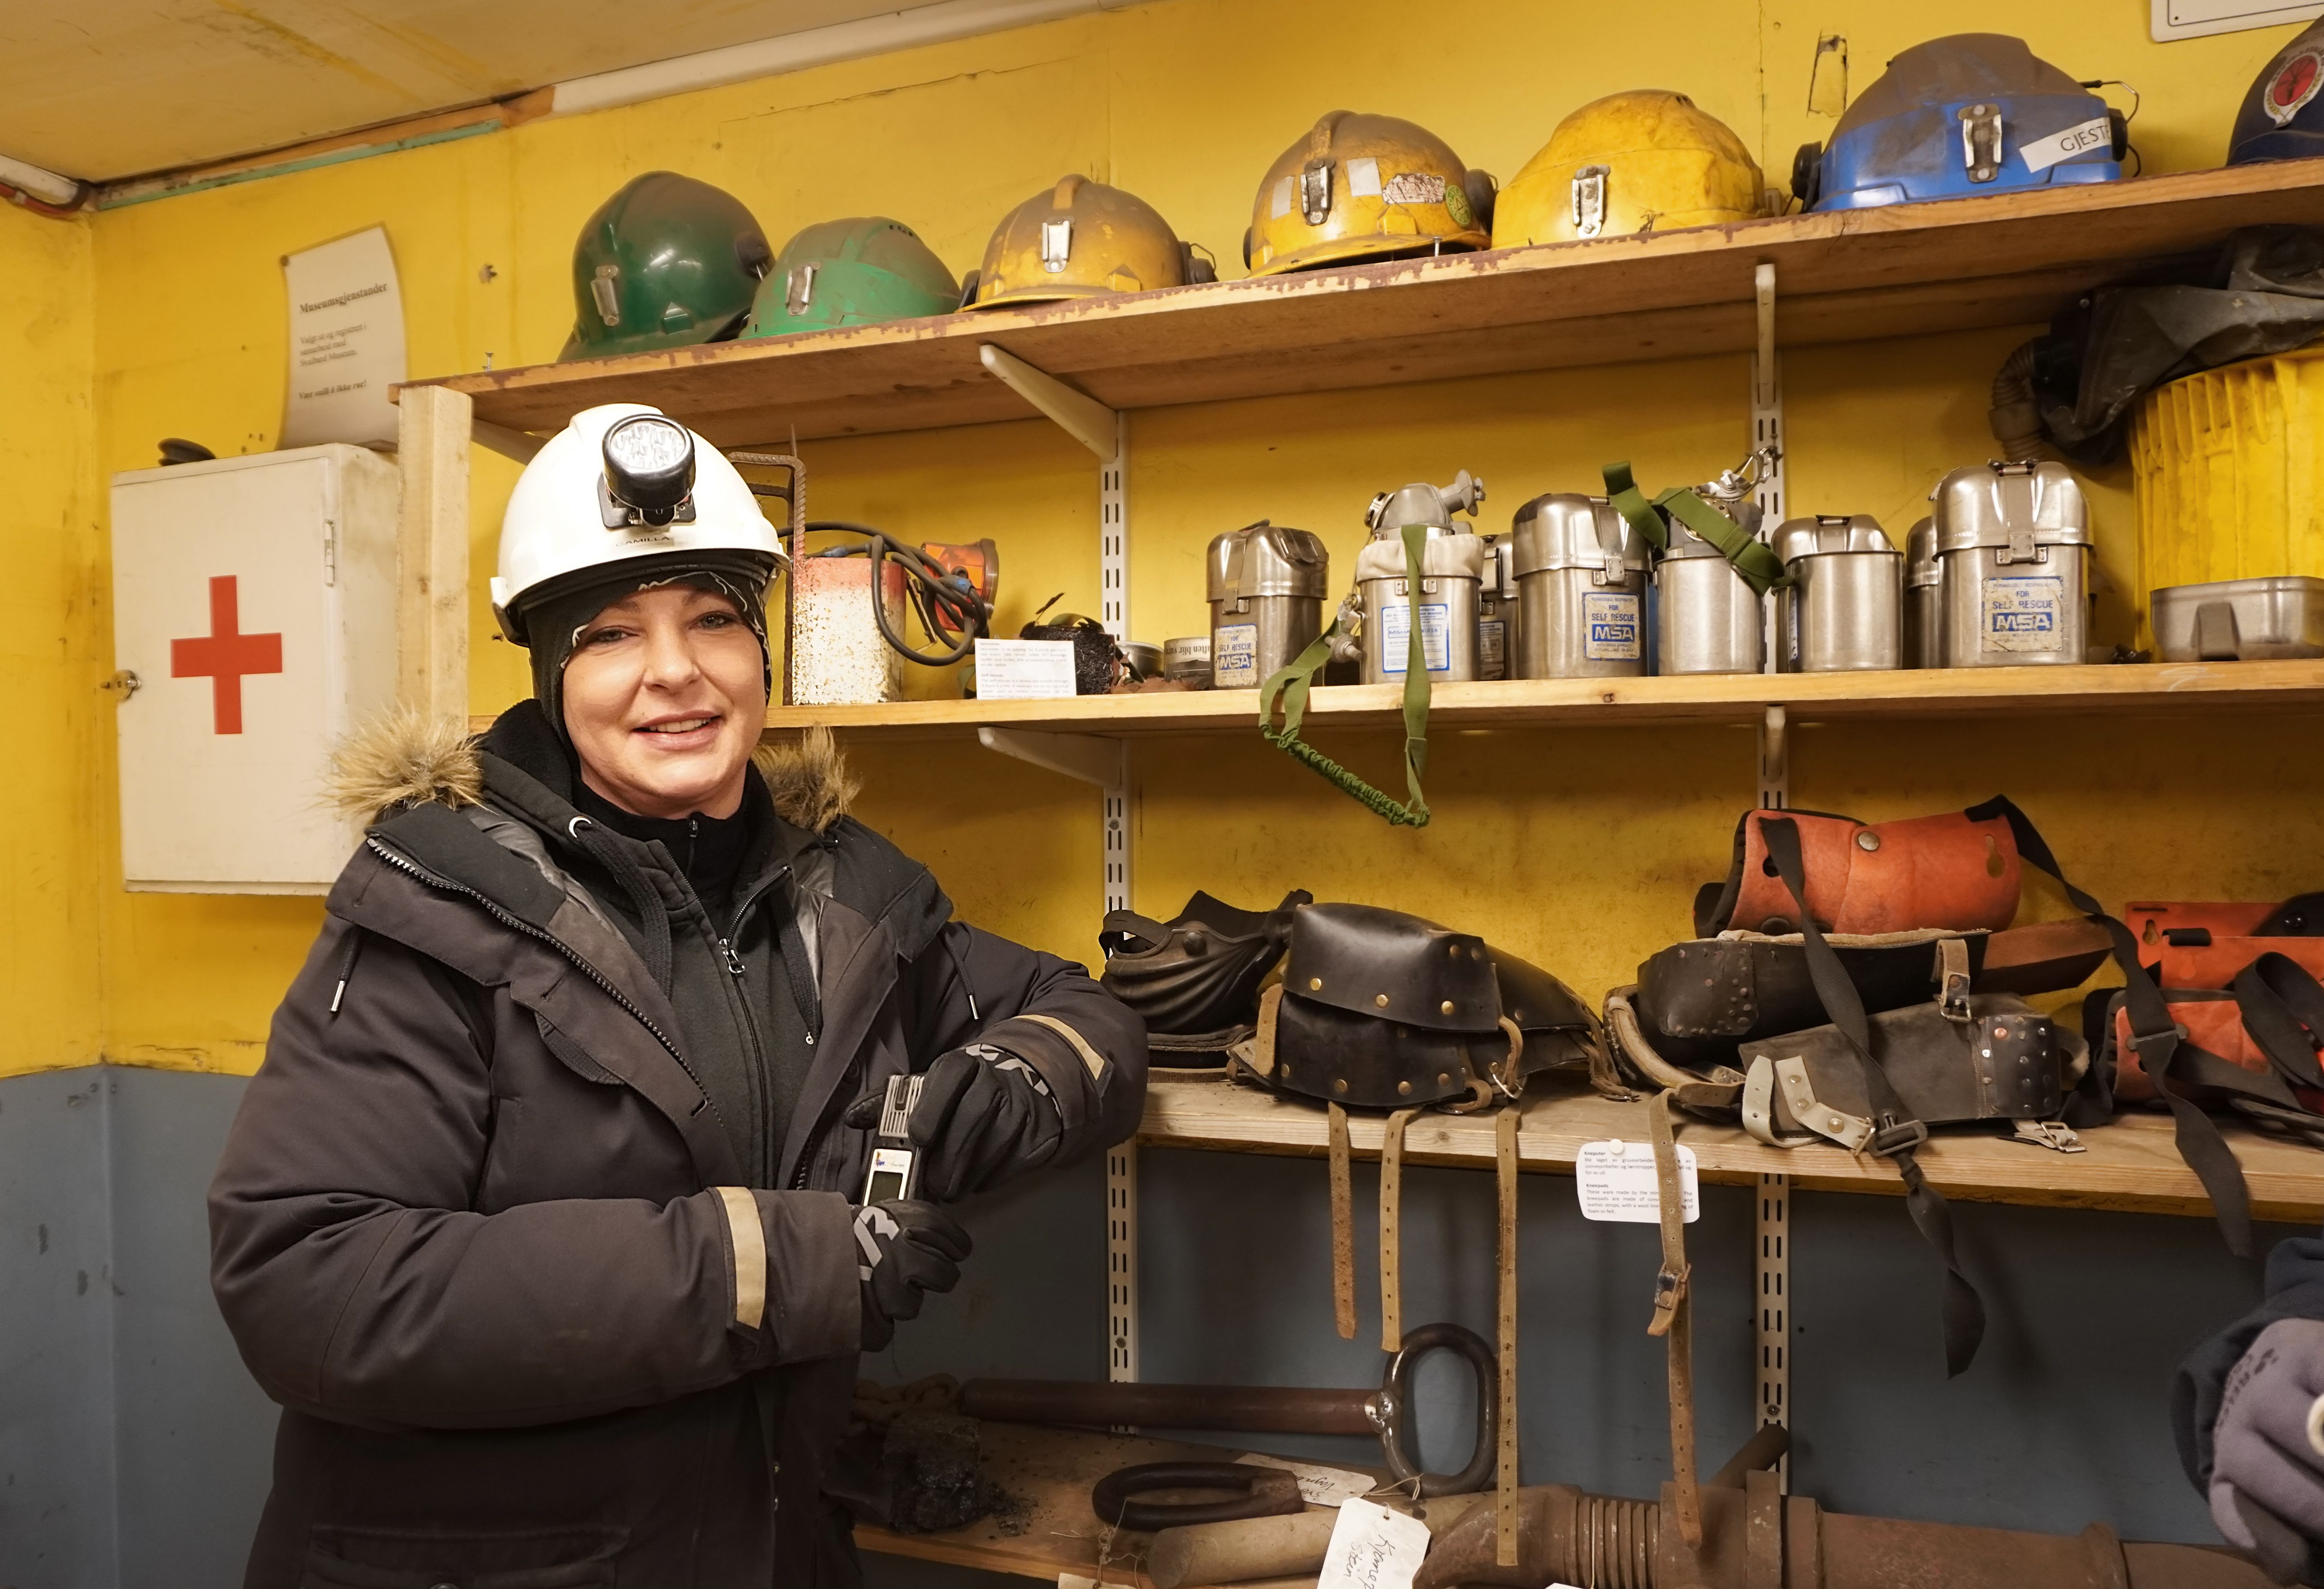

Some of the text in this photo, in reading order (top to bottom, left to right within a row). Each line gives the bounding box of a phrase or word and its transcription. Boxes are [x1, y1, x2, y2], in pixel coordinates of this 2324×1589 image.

[299, 283, 387, 313] Museumsgjenstander
[336, 384, 351, 392] ikke
[2019, 600, 2053, 609] RESCUE
[1592, 613, 1635, 622] SELF RESCUE
[1995, 614, 2051, 630] MSA
[1595, 626, 1633, 640] MSA
[1219, 643, 1251, 652] SELF RESCUE
[1220, 654, 1250, 669] MSA
